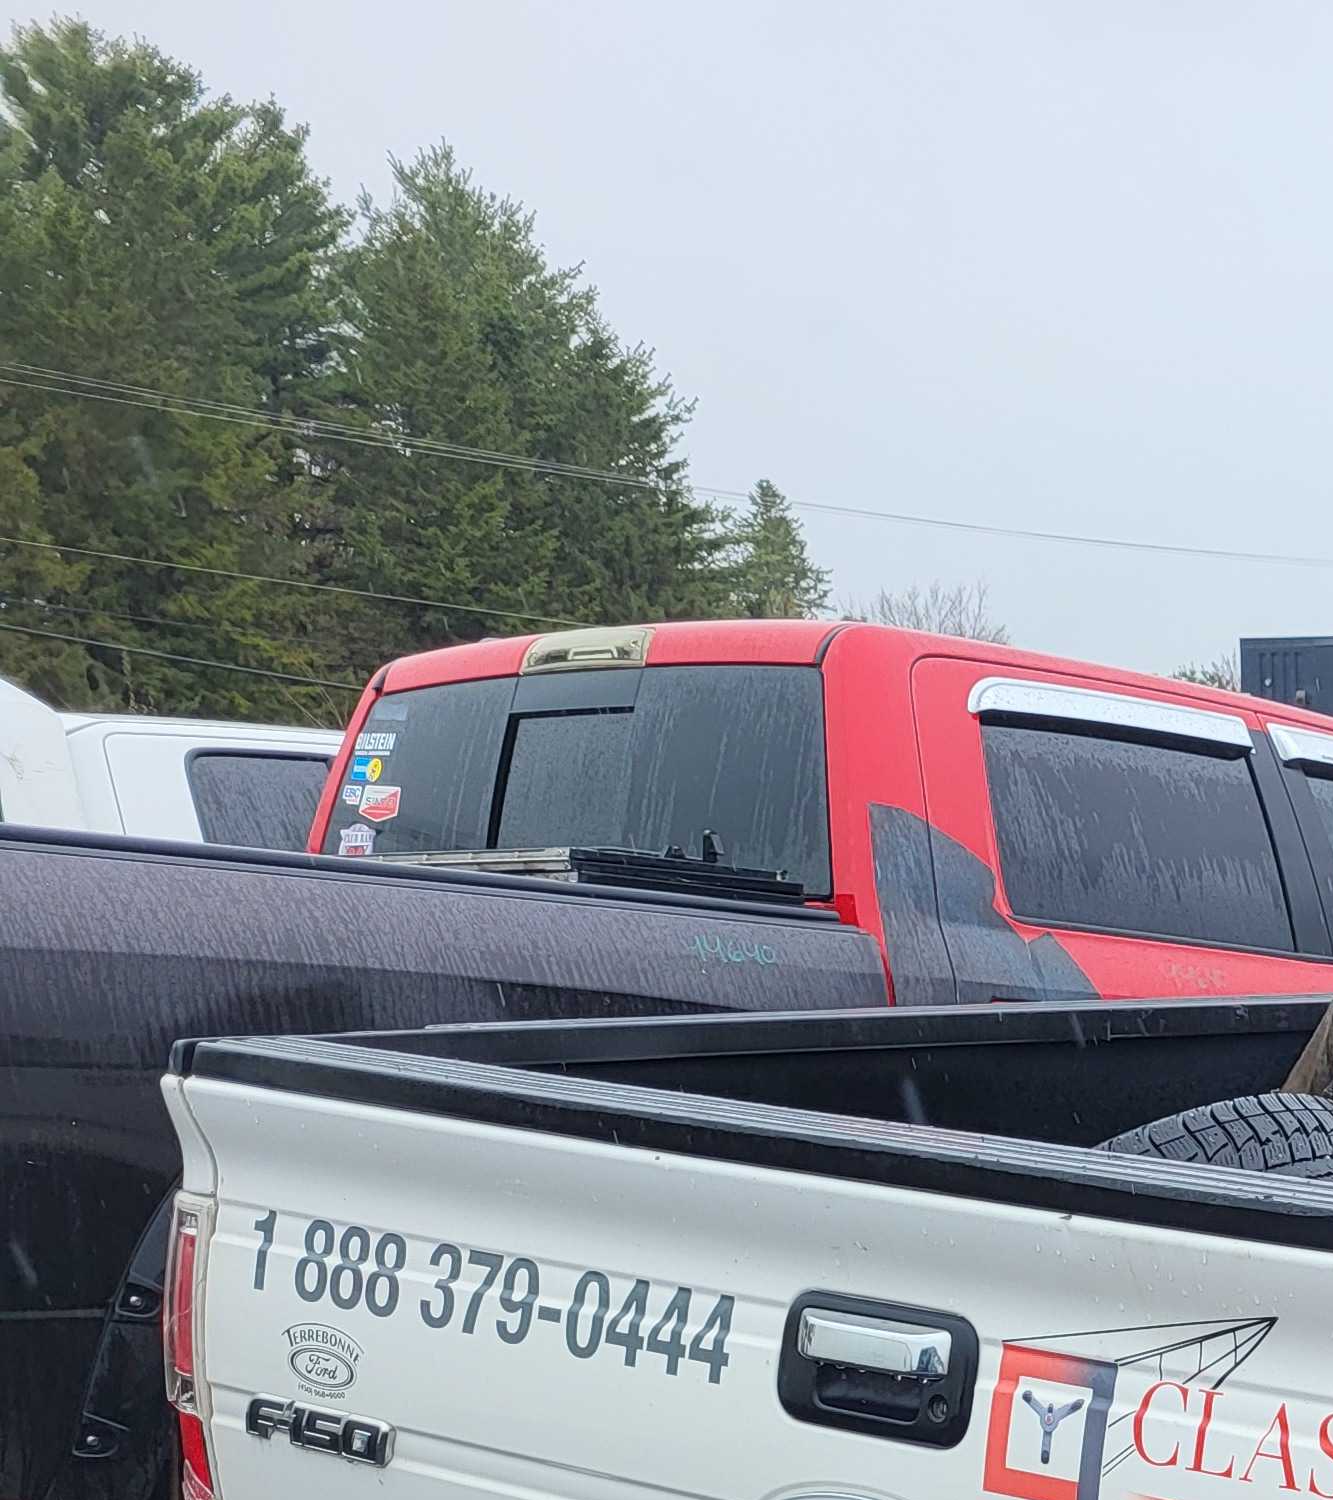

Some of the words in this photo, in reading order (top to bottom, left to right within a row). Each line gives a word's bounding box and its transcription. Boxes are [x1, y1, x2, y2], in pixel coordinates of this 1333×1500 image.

[355, 733, 396, 750] BILSTEIN
[253, 1210, 278, 1292] 1
[293, 1218, 407, 1317] 888
[419, 1243, 736, 1384] 379-0444
[282, 1323, 364, 1367] TERREBONNE
[304, 1353, 339, 1381] Ford
[246, 1396, 394, 1468] F-150
